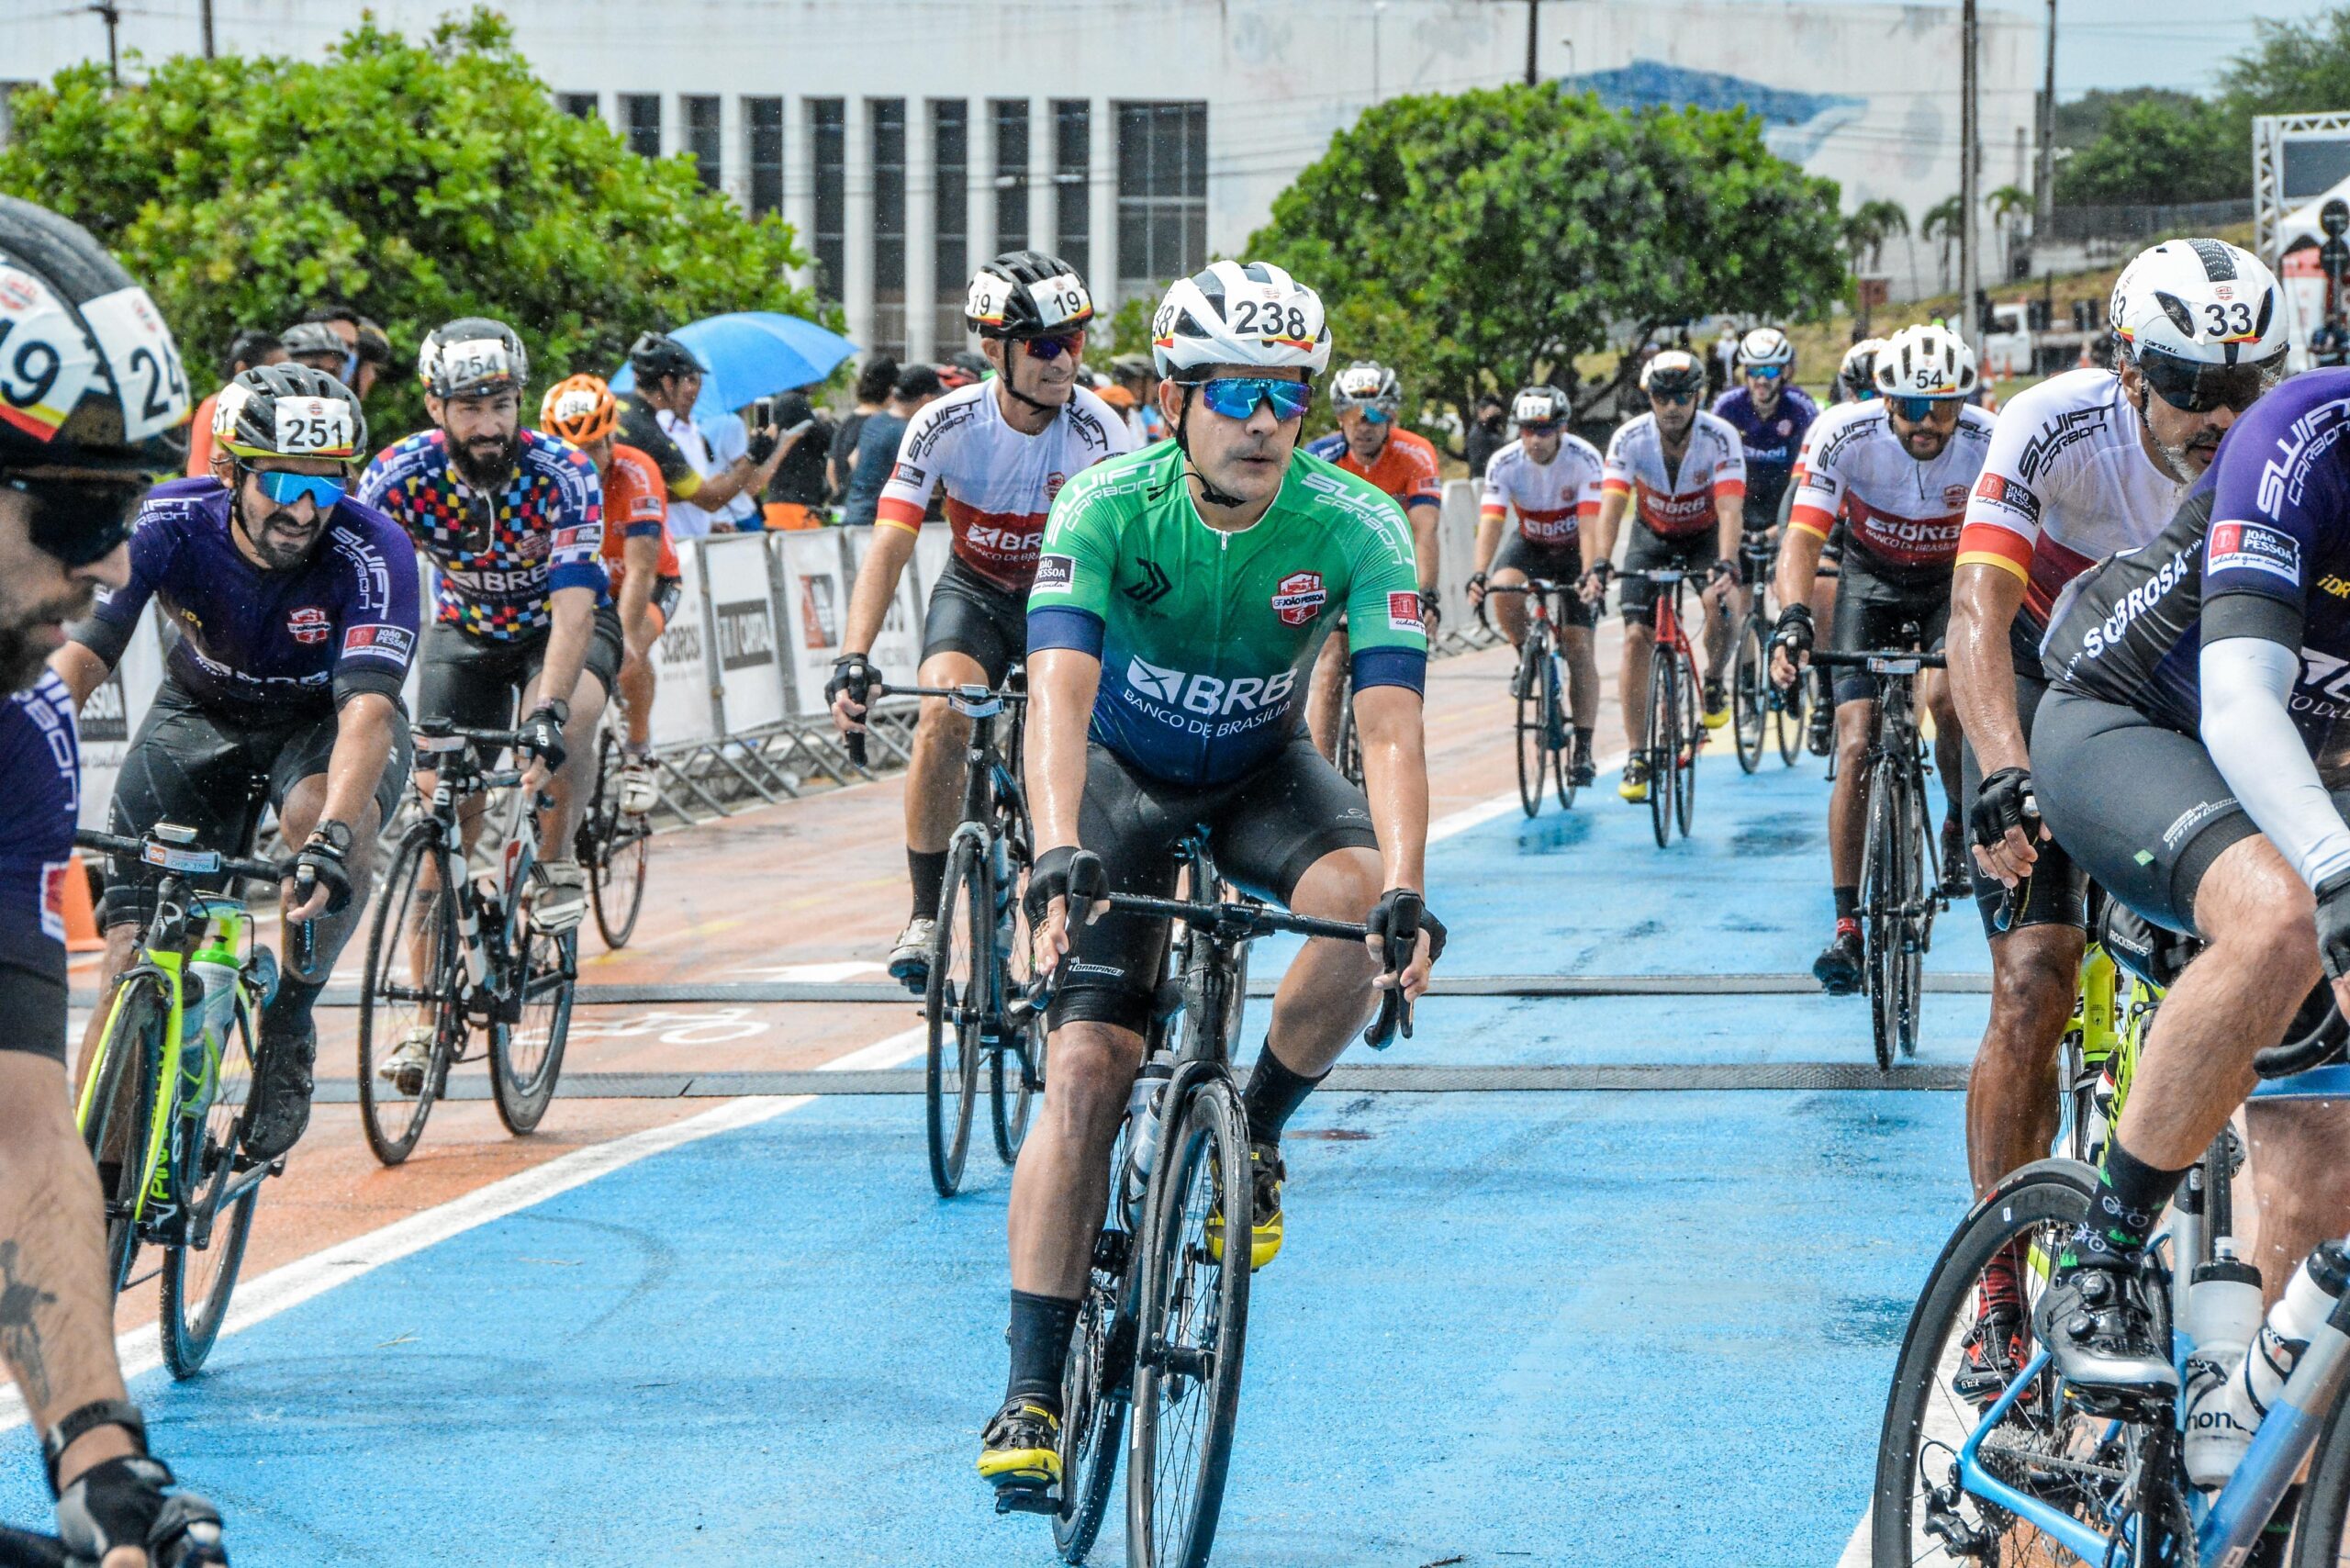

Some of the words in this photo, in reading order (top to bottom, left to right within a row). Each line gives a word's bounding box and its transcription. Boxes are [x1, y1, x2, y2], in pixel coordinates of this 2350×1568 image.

[973, 294, 991, 317] 19
[1053, 290, 1081, 317] 19
[1234, 299, 1307, 342] 238
[2204, 302, 2253, 337] 33
[1915, 369, 1944, 389] 54
[285, 418, 342, 448] 251
[907, 398, 981, 463] SWIFT
[922, 413, 975, 458] CARBON
[1817, 416, 1885, 472] SWIFT
[2018, 402, 2116, 487] SWIFT
[2039, 422, 2108, 477] CARBON
[527, 448, 588, 521] SWIFT
[1046, 454, 1172, 548] SWIFT
[1064, 476, 1157, 532] CARBON
[966, 541, 1002, 561] BANCO
[1000, 530, 1043, 550] BR
[1300, 472, 1419, 584] SWIFT
[1314, 493, 1403, 565] CARBON
[2243, 538, 2293, 562] PESSOA
[2244, 529, 2277, 543] JOÃO
[329, 525, 390, 621] SWIFT
[332, 545, 371, 610] CARBON
[482, 562, 549, 592] BRB
[2082, 551, 2188, 660] SOBROSA
[1123, 688, 1185, 729] BANCO
[1187, 719, 1213, 739] DE
[1215, 699, 1292, 738] BRASÍLIA
[1182, 667, 1298, 716] BRB
[1230, 905, 1255, 914] GARMIN
[2108, 928, 2149, 958] ROCKBROS
